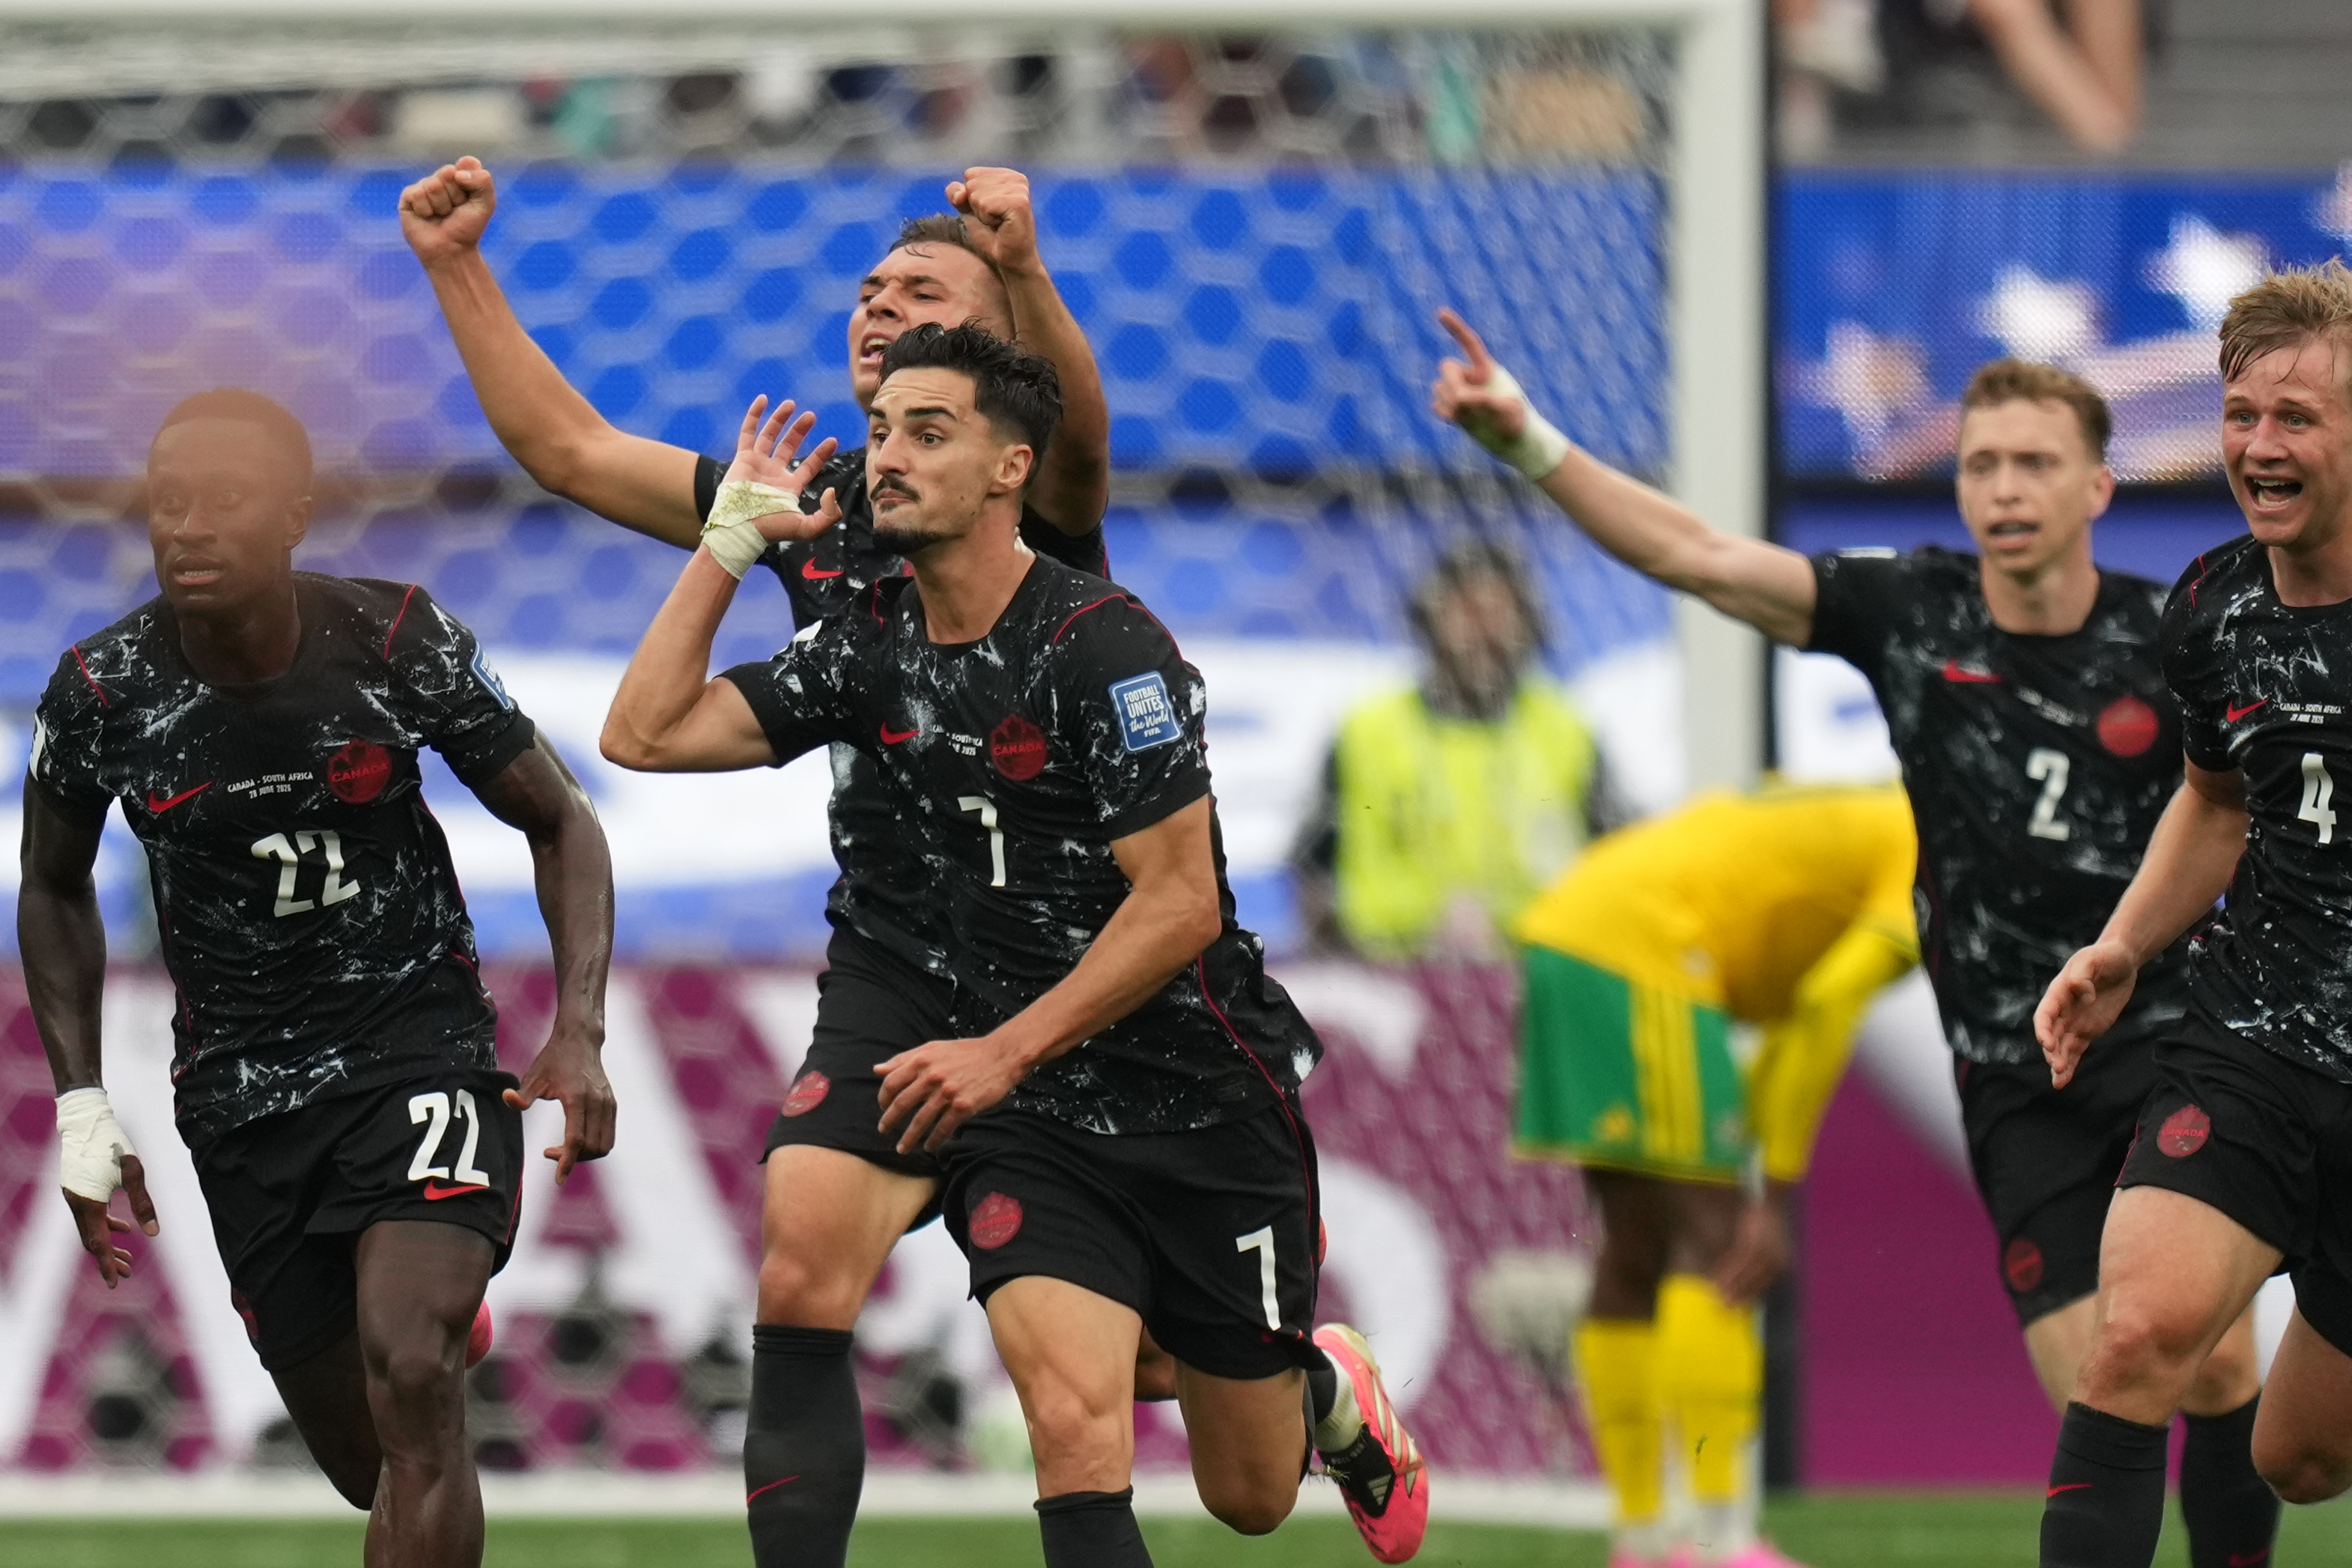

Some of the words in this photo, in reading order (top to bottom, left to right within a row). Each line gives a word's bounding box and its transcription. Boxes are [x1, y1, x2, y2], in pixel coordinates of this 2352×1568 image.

[1124, 684, 1160, 704] FOOTBALL
[1127, 695, 1164, 719] UNITES
[2304, 704, 2323, 713] SOUTH
[2323, 705, 2342, 714] AFRICA
[1129, 718, 1145, 733] the
[1143, 709, 1170, 728] World
[1143, 727, 1162, 738] FIFA
[993, 741, 1043, 756] CANADA
[227, 779, 255, 793] CANADA
[262, 774, 285, 784] SOUTH
[288, 771, 313, 781] AFRICA
[331, 763, 388, 783] CANADA
[259, 785, 275, 796] JUNE
[2026, 747, 2070, 841] 2
[2297, 753, 2337, 845] 4
[957, 796, 1006, 887] 7
[251, 830, 361, 918] 22
[407, 1088, 490, 1187] 22
[2161, 1128, 2205, 1137] CANADA
[1236, 1225, 1281, 1331] 7
